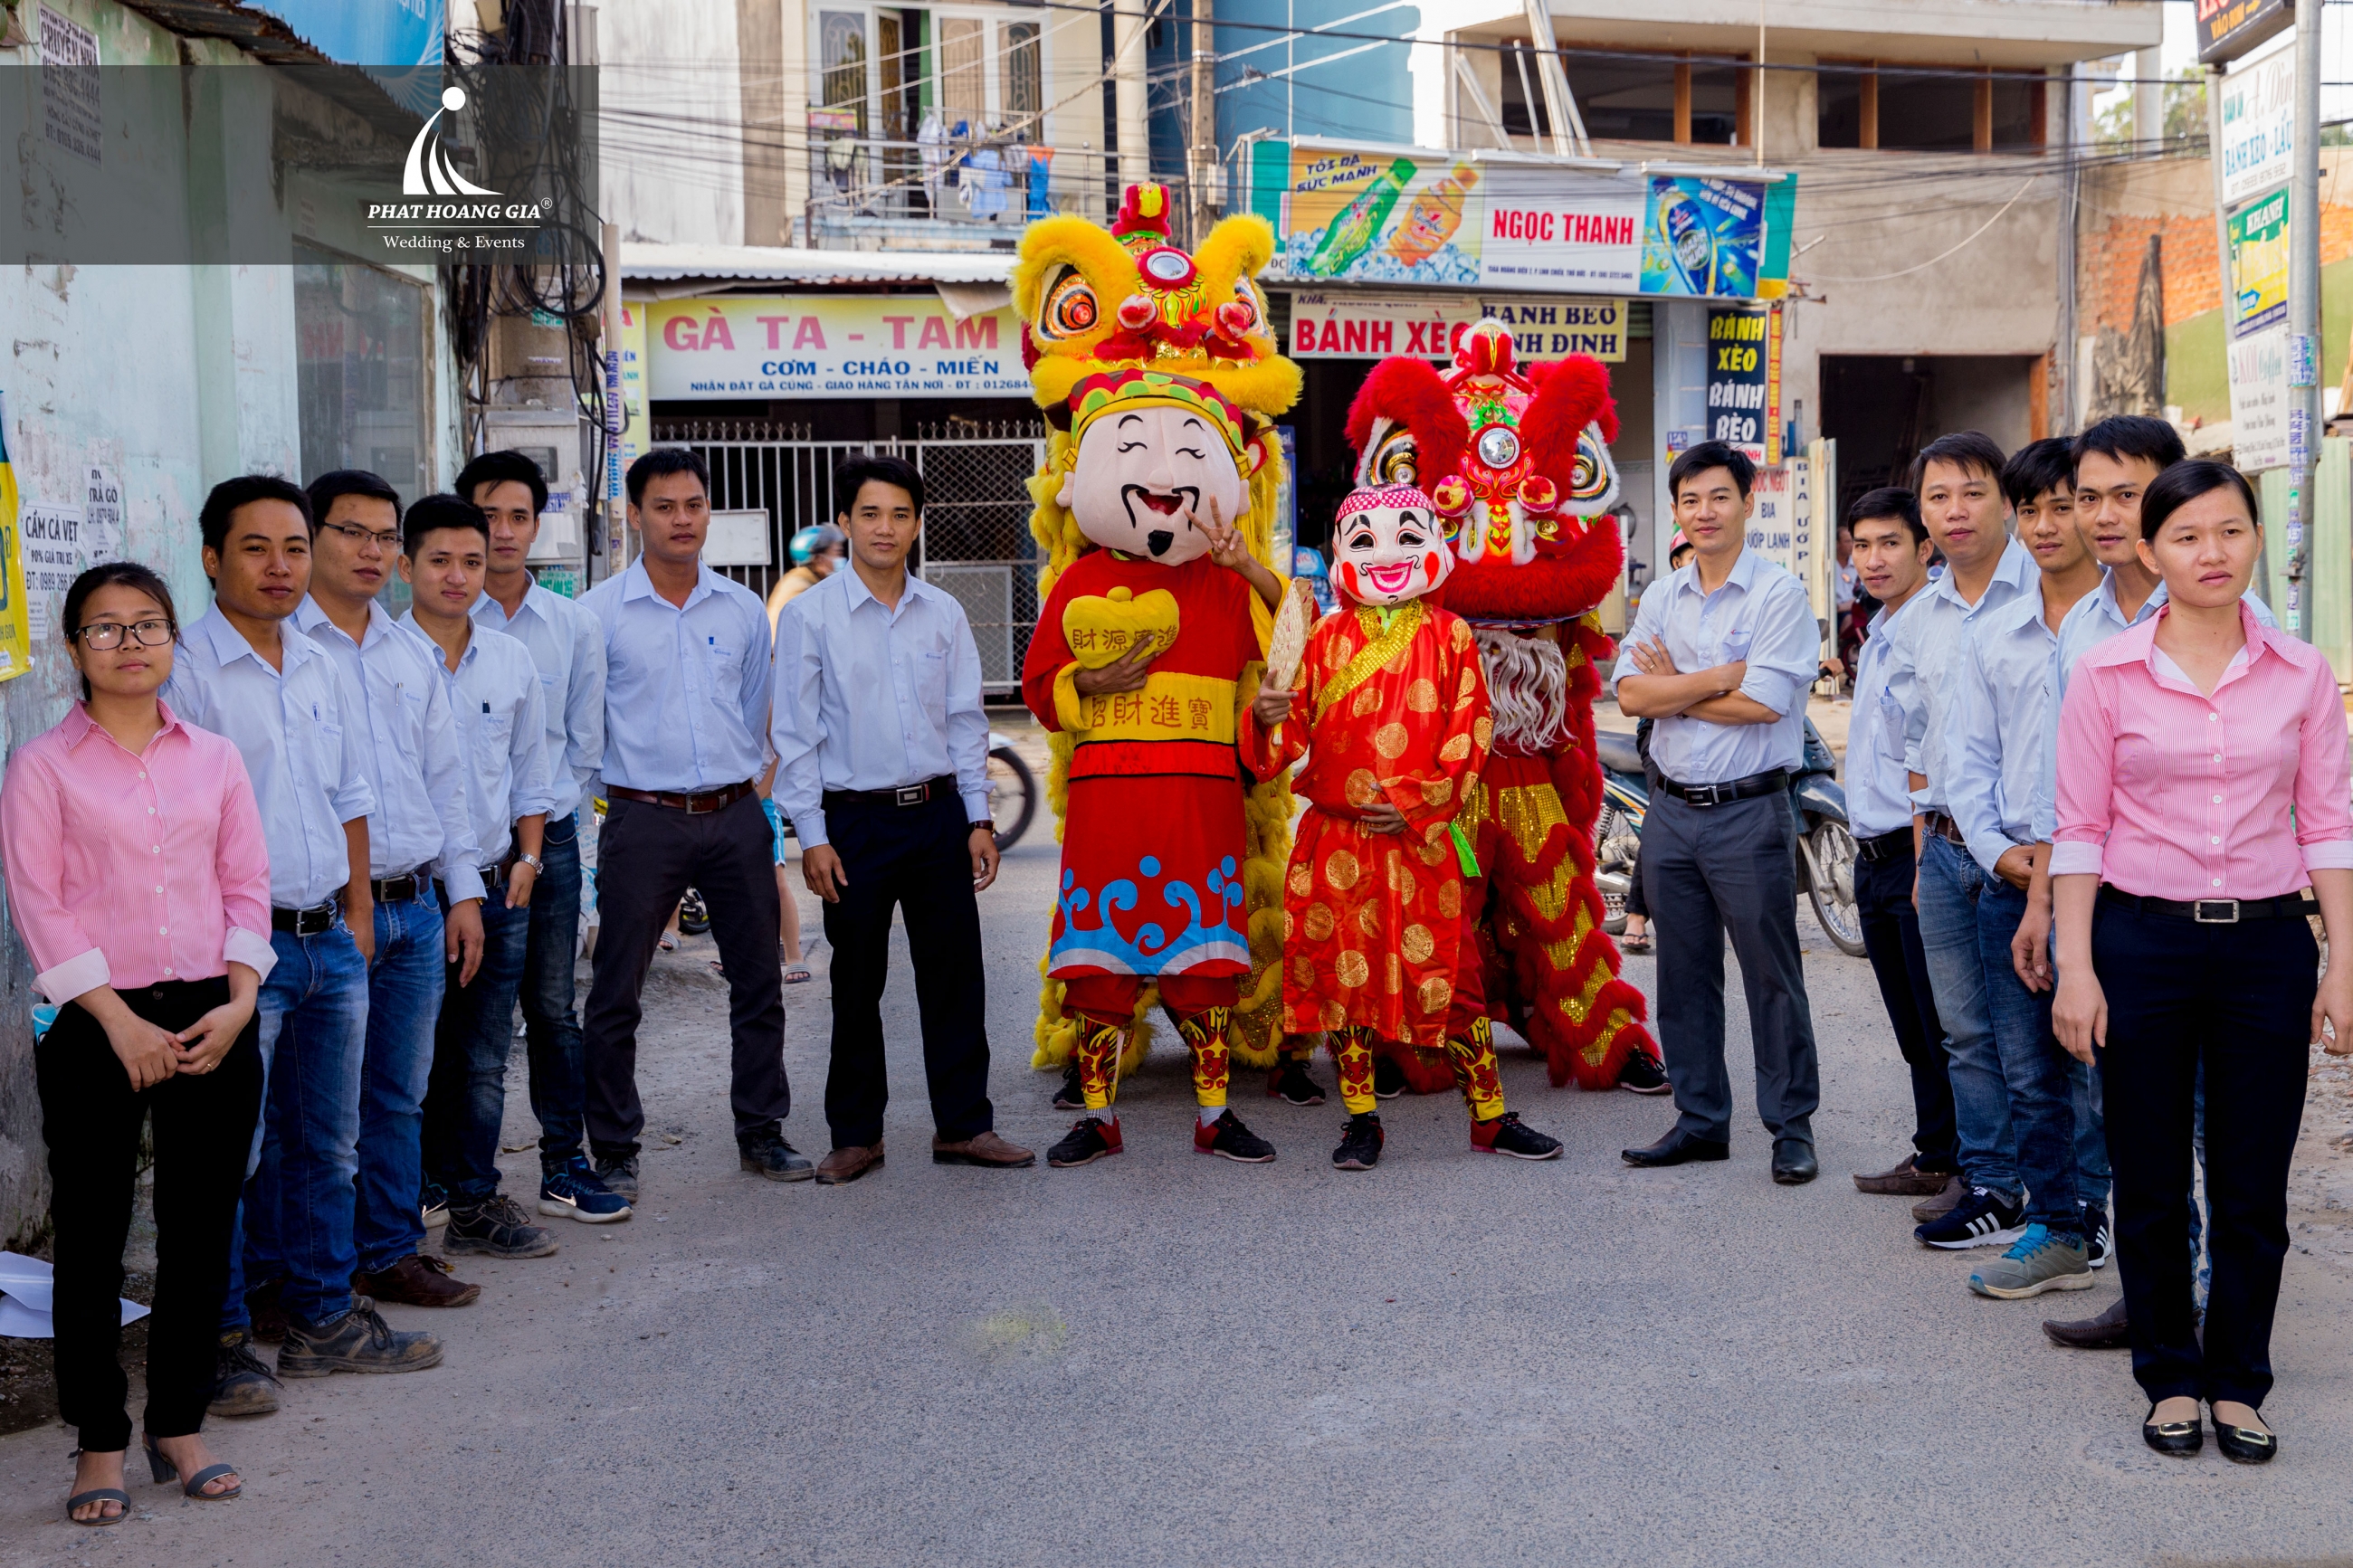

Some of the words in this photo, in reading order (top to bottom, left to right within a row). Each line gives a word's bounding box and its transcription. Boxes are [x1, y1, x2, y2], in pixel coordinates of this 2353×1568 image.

[1493, 209, 1555, 246] NGỌC
[1562, 214, 1634, 245] THANH
[662, 306, 736, 352] GÀ
[756, 315, 827, 350] TA
[882, 315, 999, 350] TAM
[1296, 308, 1394, 354] BÁNH
[1710, 312, 1766, 341] BÁNH
[761, 357, 817, 376] CƠM
[843, 355, 910, 376] CHÁO
[936, 354, 1000, 375] MIẾN
[1717, 343, 1758, 372] XÈO
[825, 380, 853, 391] GIAO
[858, 379, 891, 391] HÀNG
[1709, 378, 1765, 409] BÁNH
[1715, 412, 1757, 442] BÈO
[1761, 502, 1776, 518] BIA
[48, 513, 61, 540] CÀ
[62, 519, 79, 546] VẸT
[31, 549, 43, 563] 90%
[65, 552, 72, 565] XE
[26, 571, 38, 591] ĐT:
